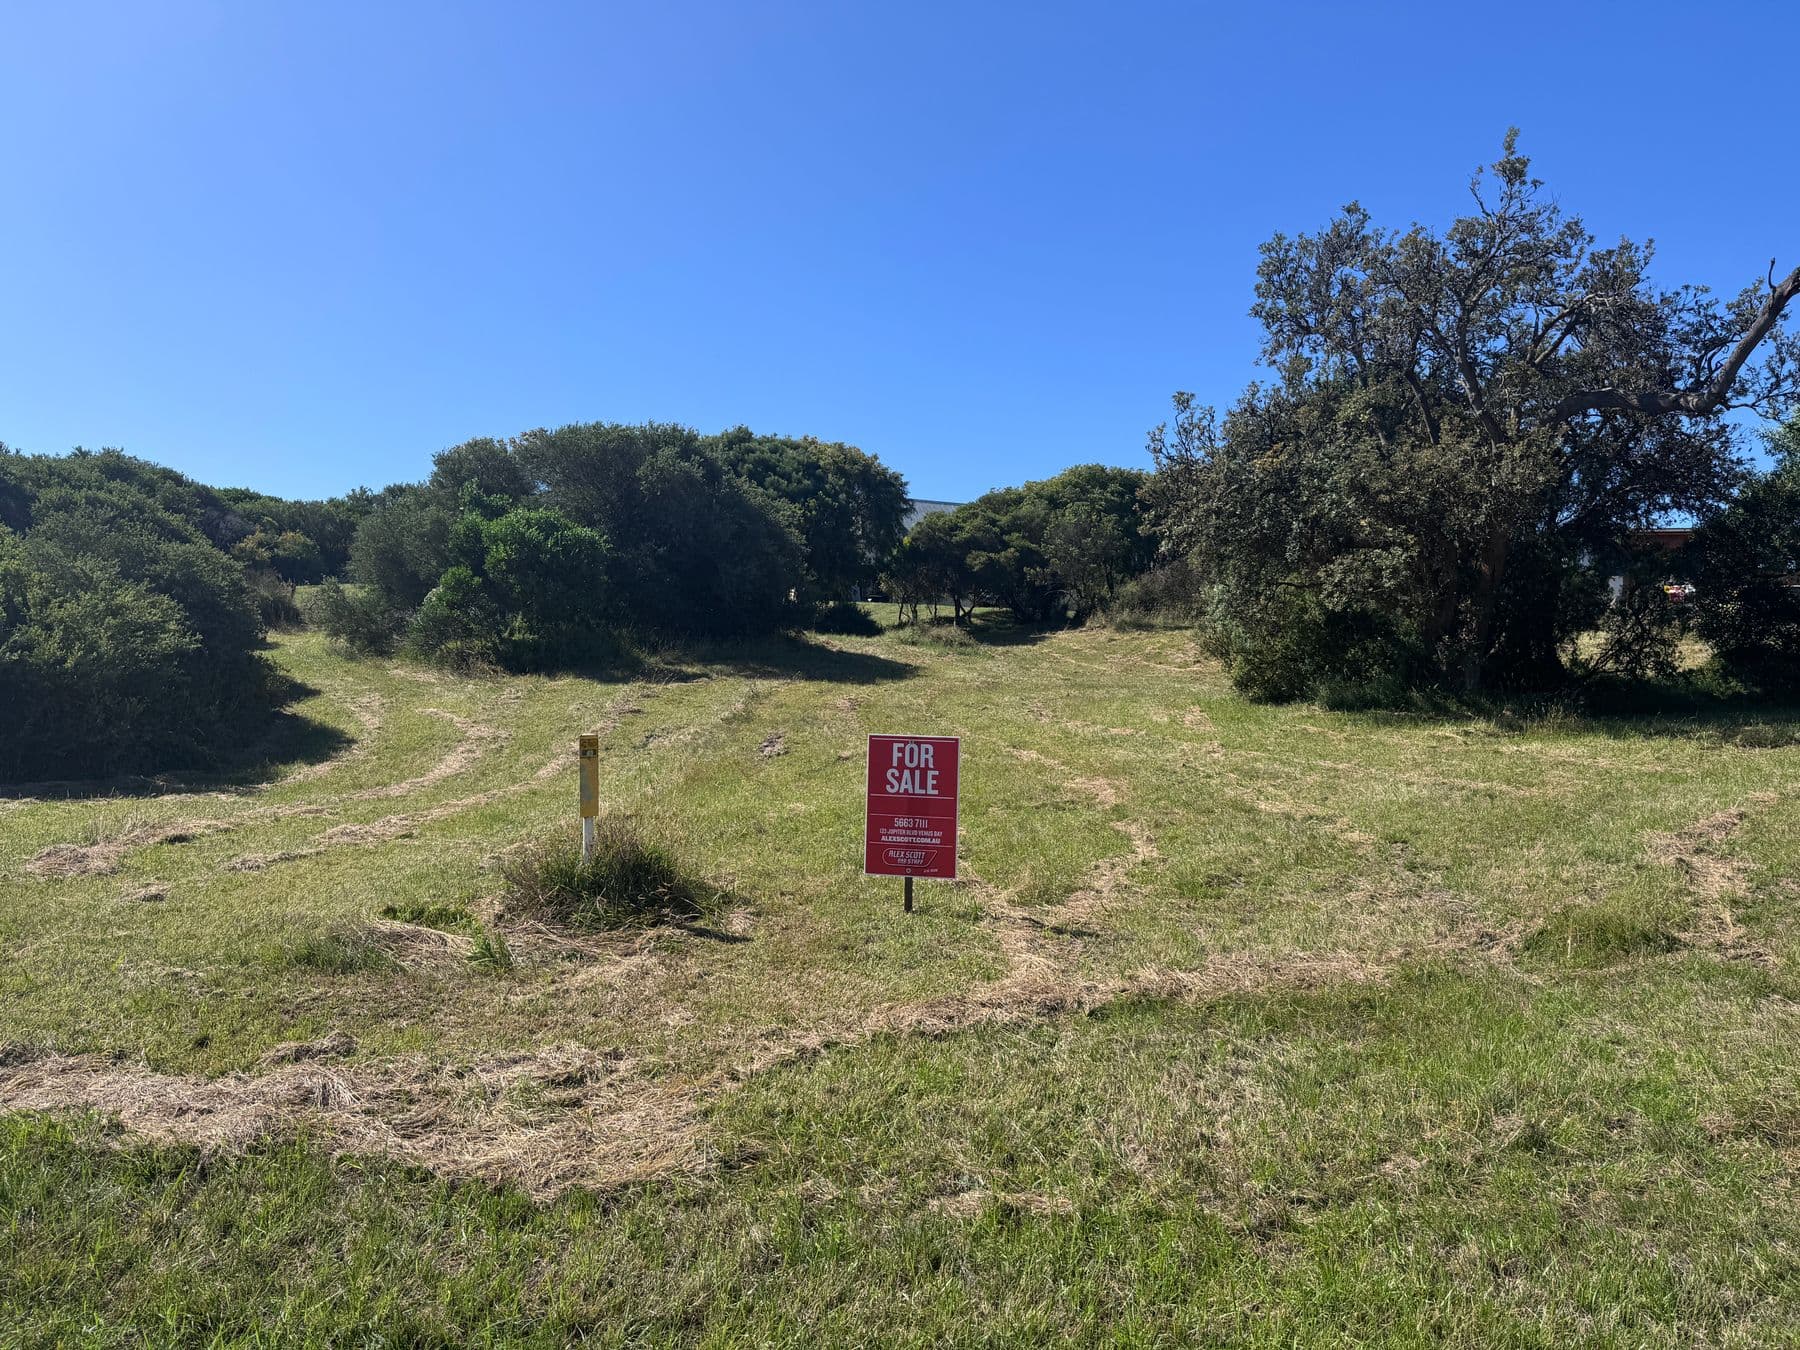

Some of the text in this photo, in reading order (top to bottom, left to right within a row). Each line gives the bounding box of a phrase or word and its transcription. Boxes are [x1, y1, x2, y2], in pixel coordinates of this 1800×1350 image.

[892, 743, 934, 768] FOR
[886, 768, 939, 795] SALE
[895, 818, 928, 828] 5663 7111
[905, 851, 925, 859] SCOTT
